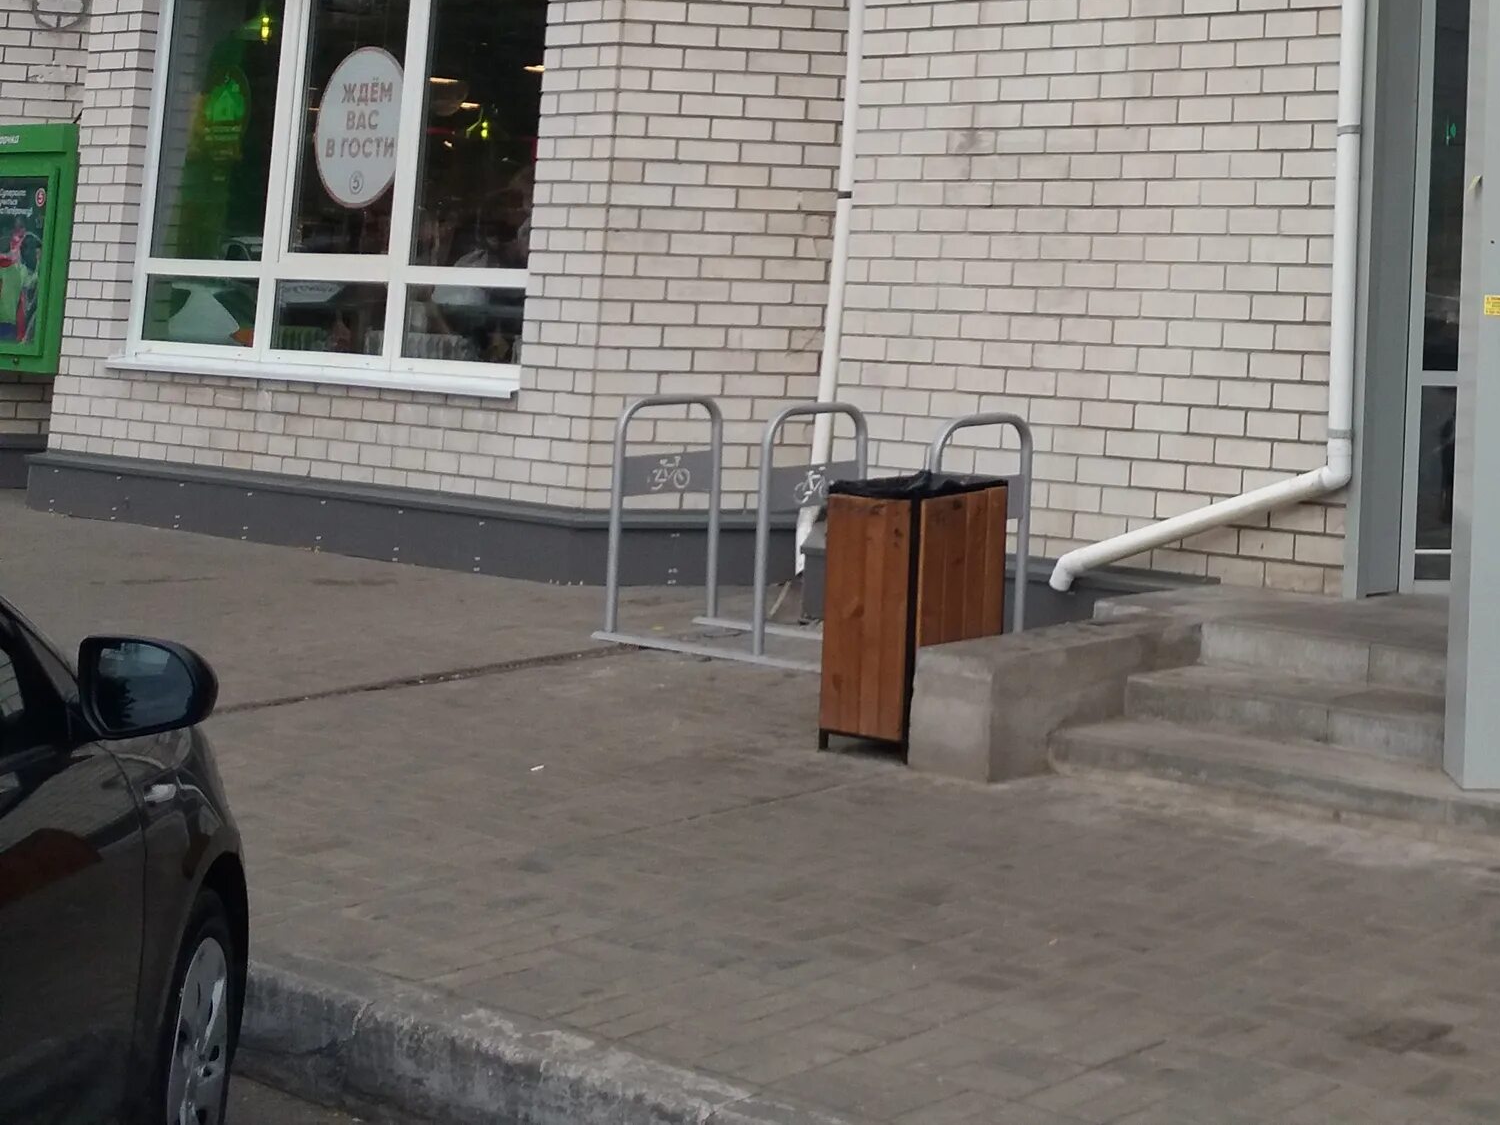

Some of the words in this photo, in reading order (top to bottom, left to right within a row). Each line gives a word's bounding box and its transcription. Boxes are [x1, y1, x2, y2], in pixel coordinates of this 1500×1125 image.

[341, 77, 393, 105] ЖДЁМ
[345, 109, 380, 130] ВАС
[325, 138, 336, 158] В
[340, 137, 396, 158] ГОСТИ
